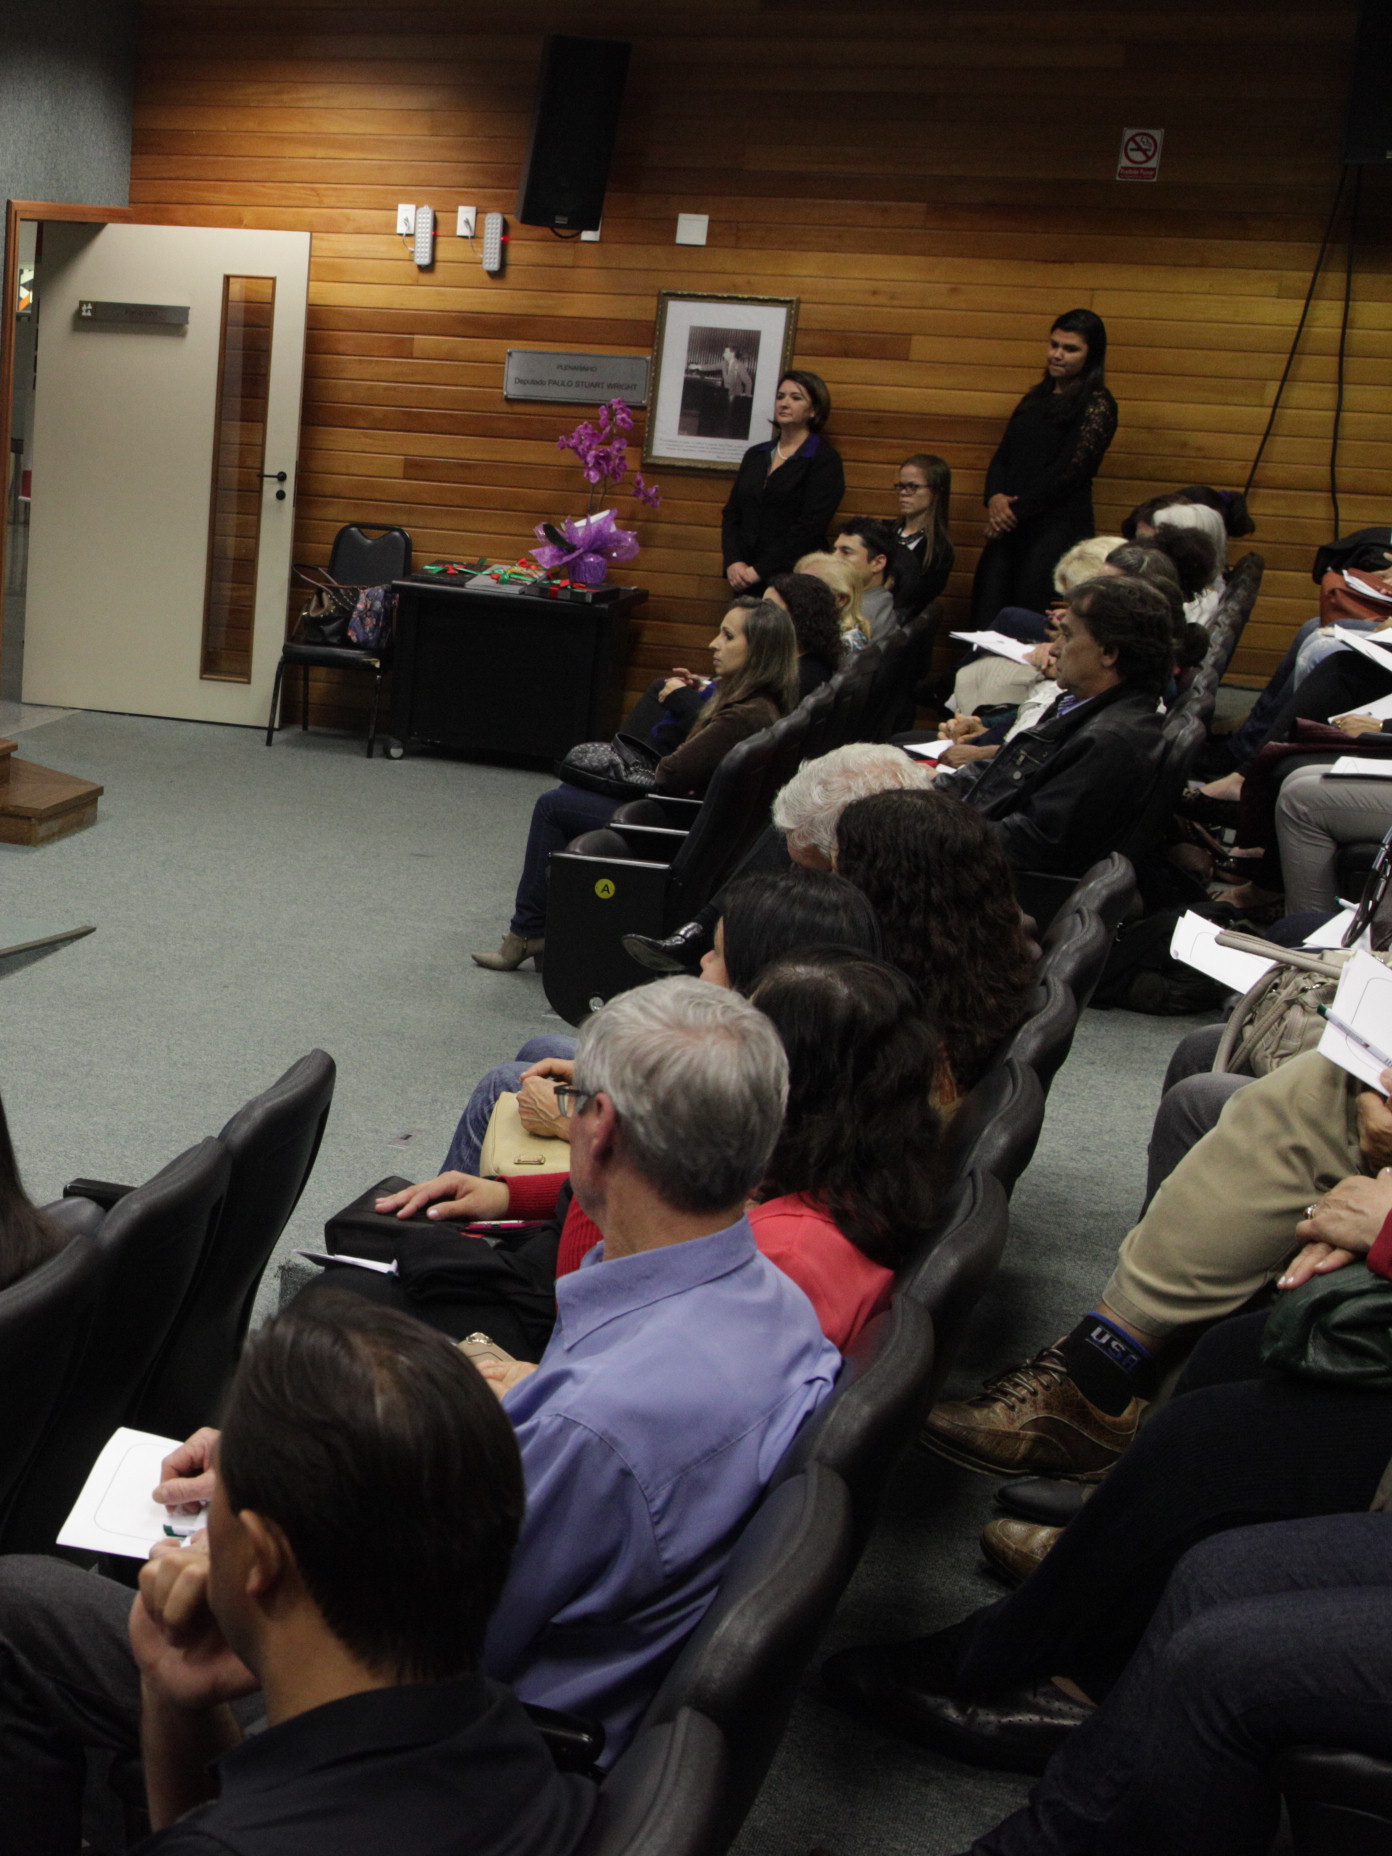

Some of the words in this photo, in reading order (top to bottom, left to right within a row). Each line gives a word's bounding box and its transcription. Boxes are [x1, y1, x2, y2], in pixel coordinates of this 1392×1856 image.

[514, 377, 547, 387] Deputado
[547, 379, 573, 388] PAULO
[574, 380, 605, 390] STUART
[606, 382, 638, 391] WRIGHT
[601, 883, 611, 895] A
[1090, 1326, 1139, 1369] USA
